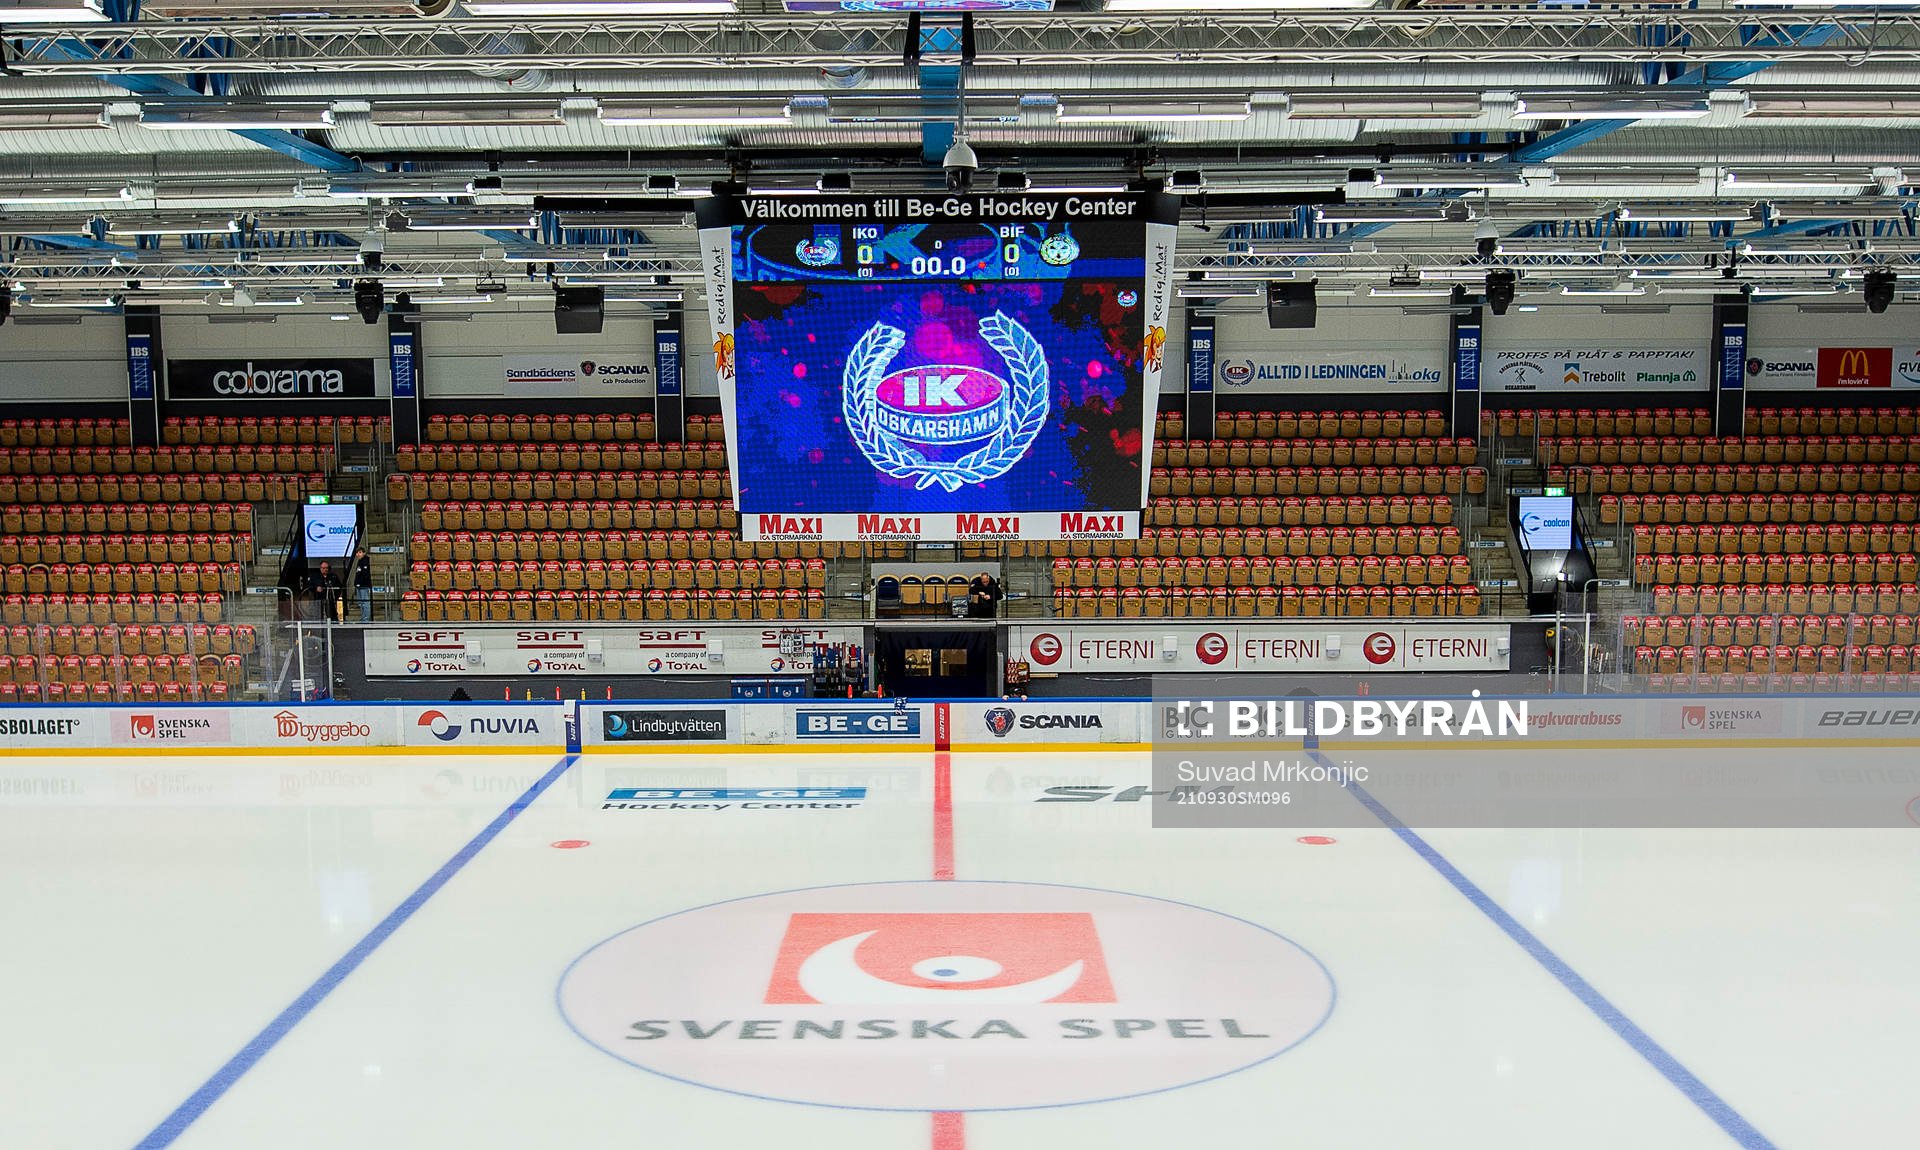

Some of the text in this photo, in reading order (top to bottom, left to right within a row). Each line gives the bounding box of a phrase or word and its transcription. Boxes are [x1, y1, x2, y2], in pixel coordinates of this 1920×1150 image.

[741, 197, 1137, 219] Välkommen till Be-Ge Hockey Center
[852, 227, 878, 239] IKO
[1000, 226, 1025, 238] BIF
[857, 244, 873, 264] 0
[1004, 244, 1020, 263] 0
[911, 256, 966, 275] 00.0
[1192, 339, 1211, 349] IBS
[1459, 338, 1477, 348] IBS
[1724, 336, 1743, 346] IBS
[131, 347, 149, 357] IBS
[393, 344, 411, 355] IBS
[659, 342, 677, 352] IBS
[1497, 351, 1549, 359] PROFFS
[1576, 350, 1609, 359] PLÅT
[1628, 350, 1695, 359] PAPPTAKI
[598, 365, 650, 375] SCANIA
[1257, 365, 1386, 379] ALLTID I LEDNINGEN
[1766, 362, 1815, 371] SCANIA
[213, 362, 344, 394] colorama
[506, 367, 576, 378] Sandbäckens
[1412, 367, 1441, 383] okg
[1582, 371, 1626, 382] Trebolit
[1636, 372, 1681, 383] Plannja
[904, 374, 968, 406] IK
[878, 407, 999, 439] OSKARSHAMN
[1543, 518, 1570, 527] coolcon
[1079, 640, 1154, 659] ETERNI
[1245, 639, 1320, 658] ETERNI
[1412, 638, 1487, 658] ETERNI
[429, 652, 458, 660] company
[458, 651, 465, 659] of
[577, 651, 585, 659] of
[670, 651, 698, 659] company
[699, 650, 707, 658] of
[1519, 711, 1622, 728] ergkvarabuss
[1709, 710, 1762, 720] SVENSKA
[159, 719, 210, 728] SVENSKA
[632, 718, 721, 735] Lindbytvätten
[1020, 715, 1103, 729] SCANIA
[1709, 721, 1736, 729] SPEL
[159, 729, 186, 739] SPEL
[298, 721, 370, 741] byggebo
[602, 802, 861, 812] Hockey Center
[626, 1018, 1270, 1040] SVENSKA SPEL
